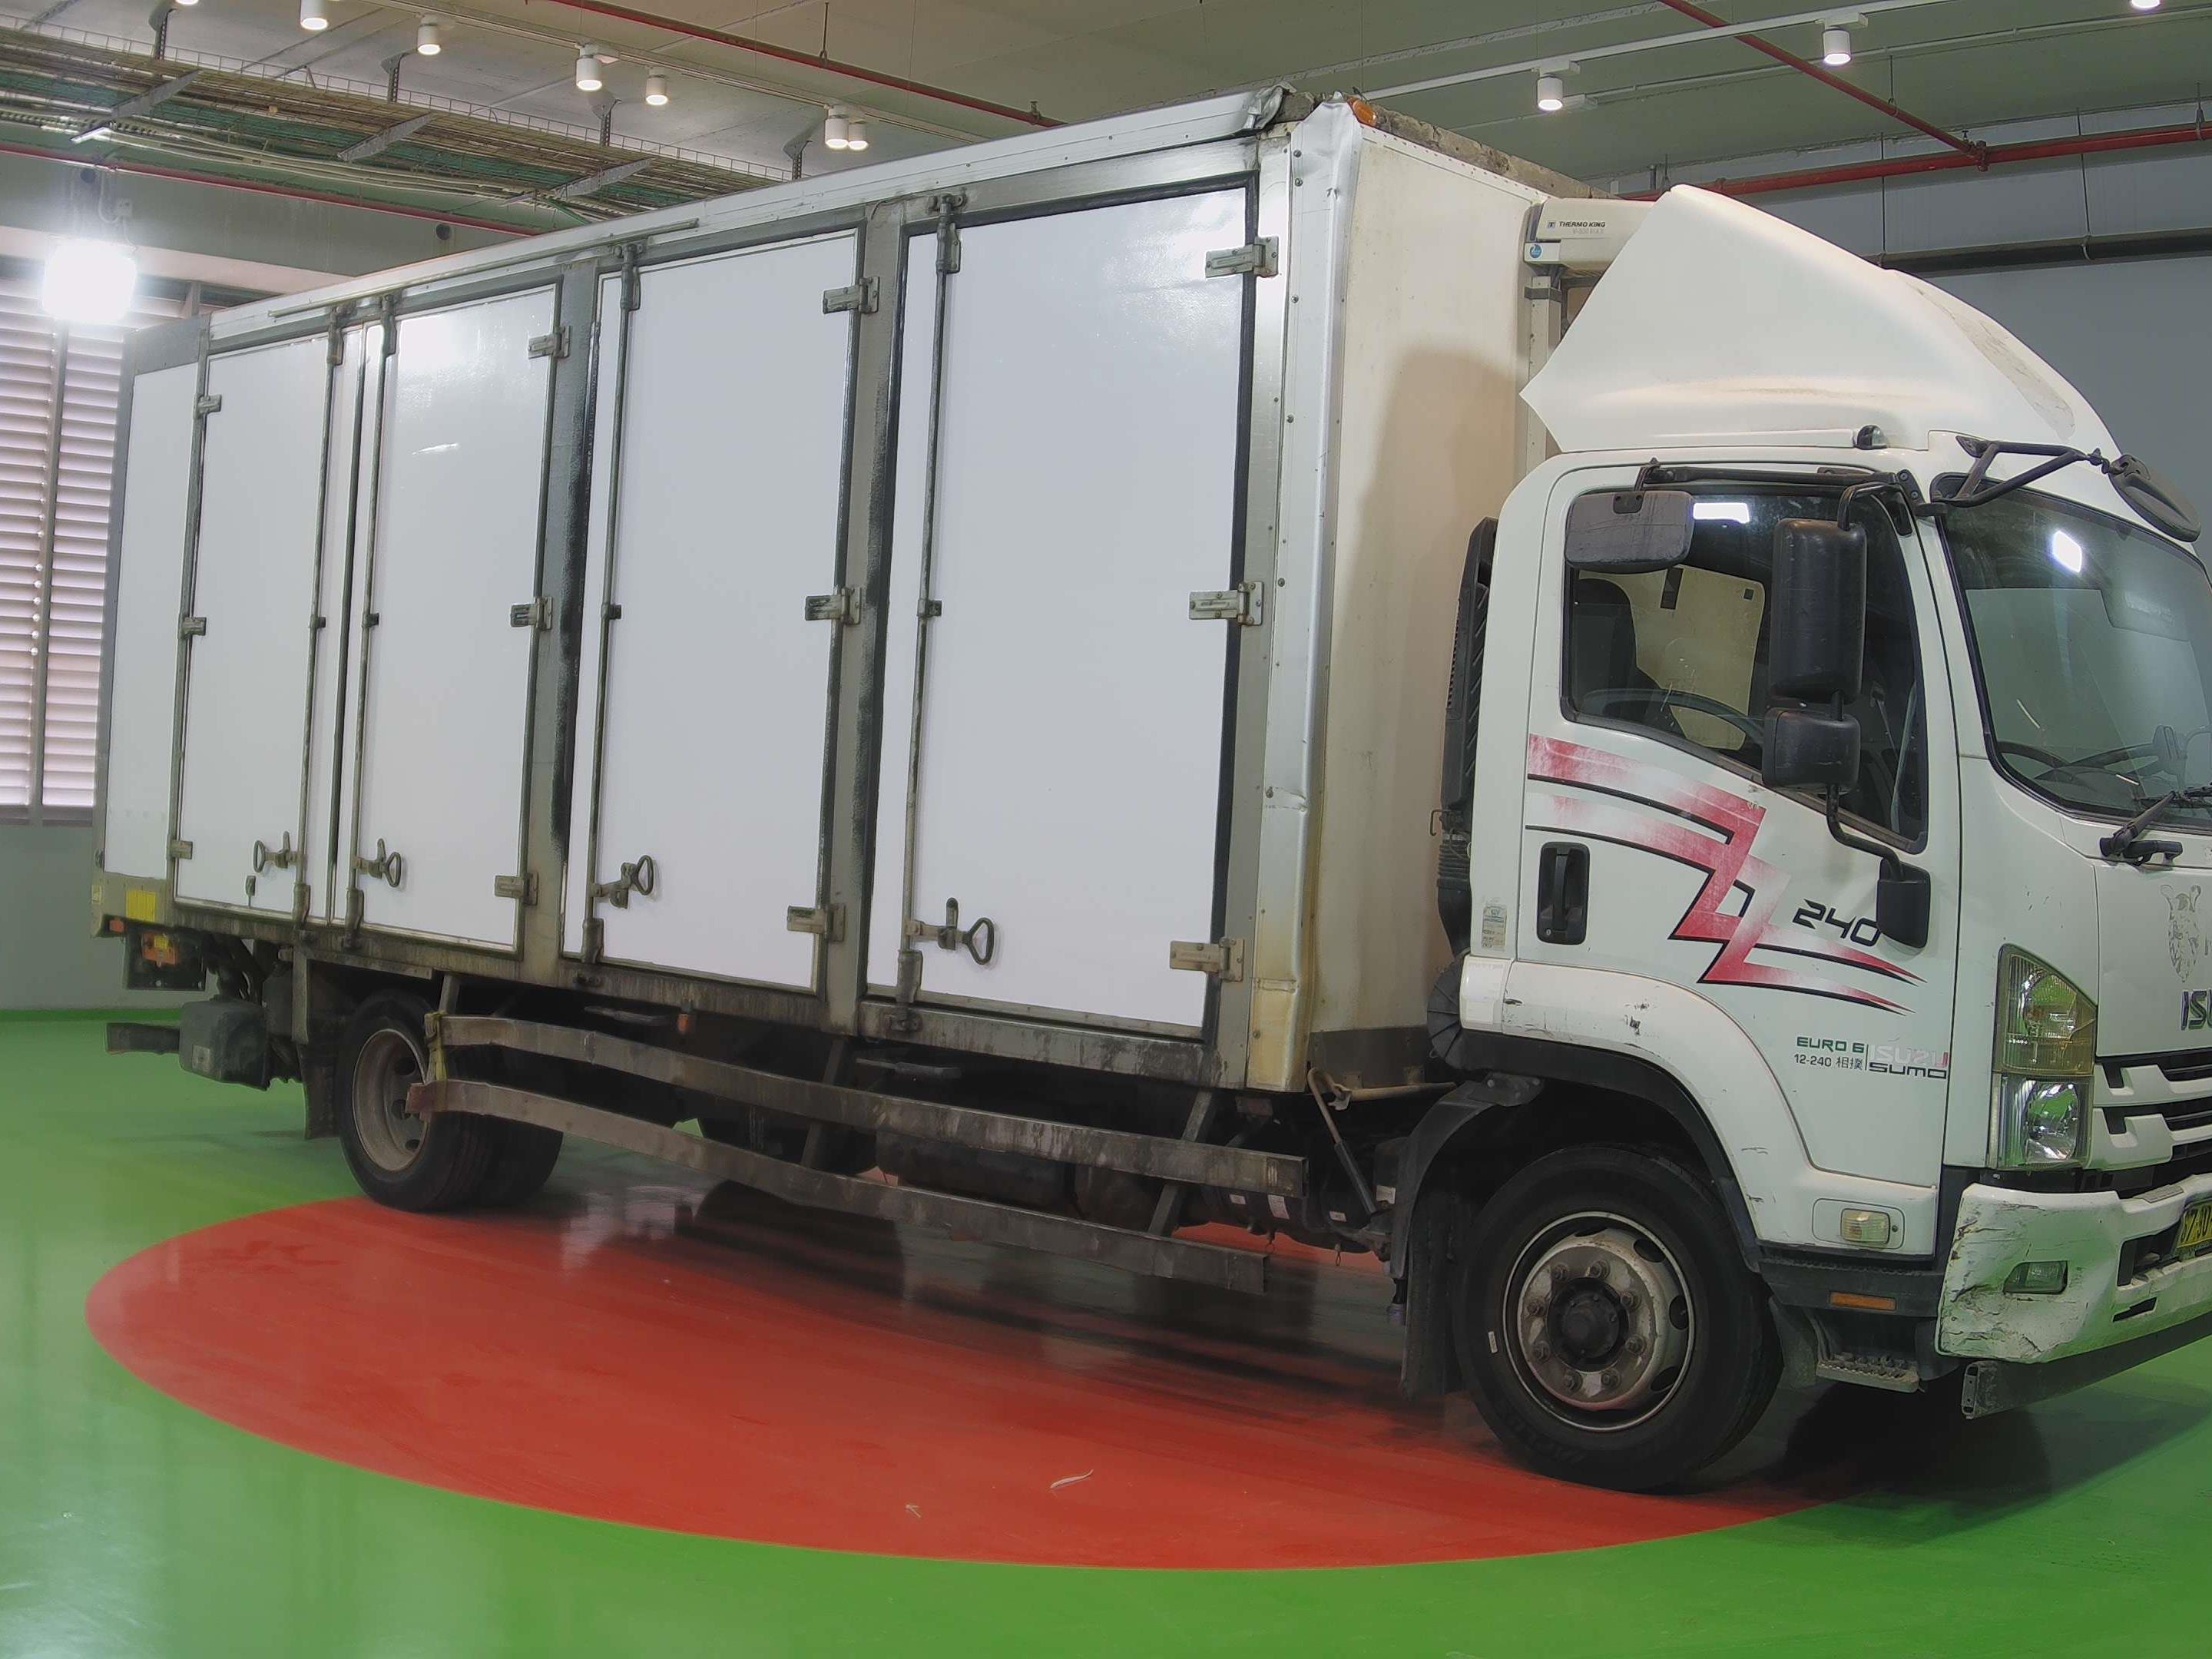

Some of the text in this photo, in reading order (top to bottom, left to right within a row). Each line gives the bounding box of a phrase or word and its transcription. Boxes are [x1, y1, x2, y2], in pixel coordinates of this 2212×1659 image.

[1792, 898, 1881, 947] 240
[2181, 989, 2212, 1031] IS
[1796, 1036, 1865, 1054] EURO 6
[1793, 1053, 1832, 1068] 12-240
[1871, 1044, 1949, 1068] ISUZU
[1869, 1061, 1947, 1080] SUMO
